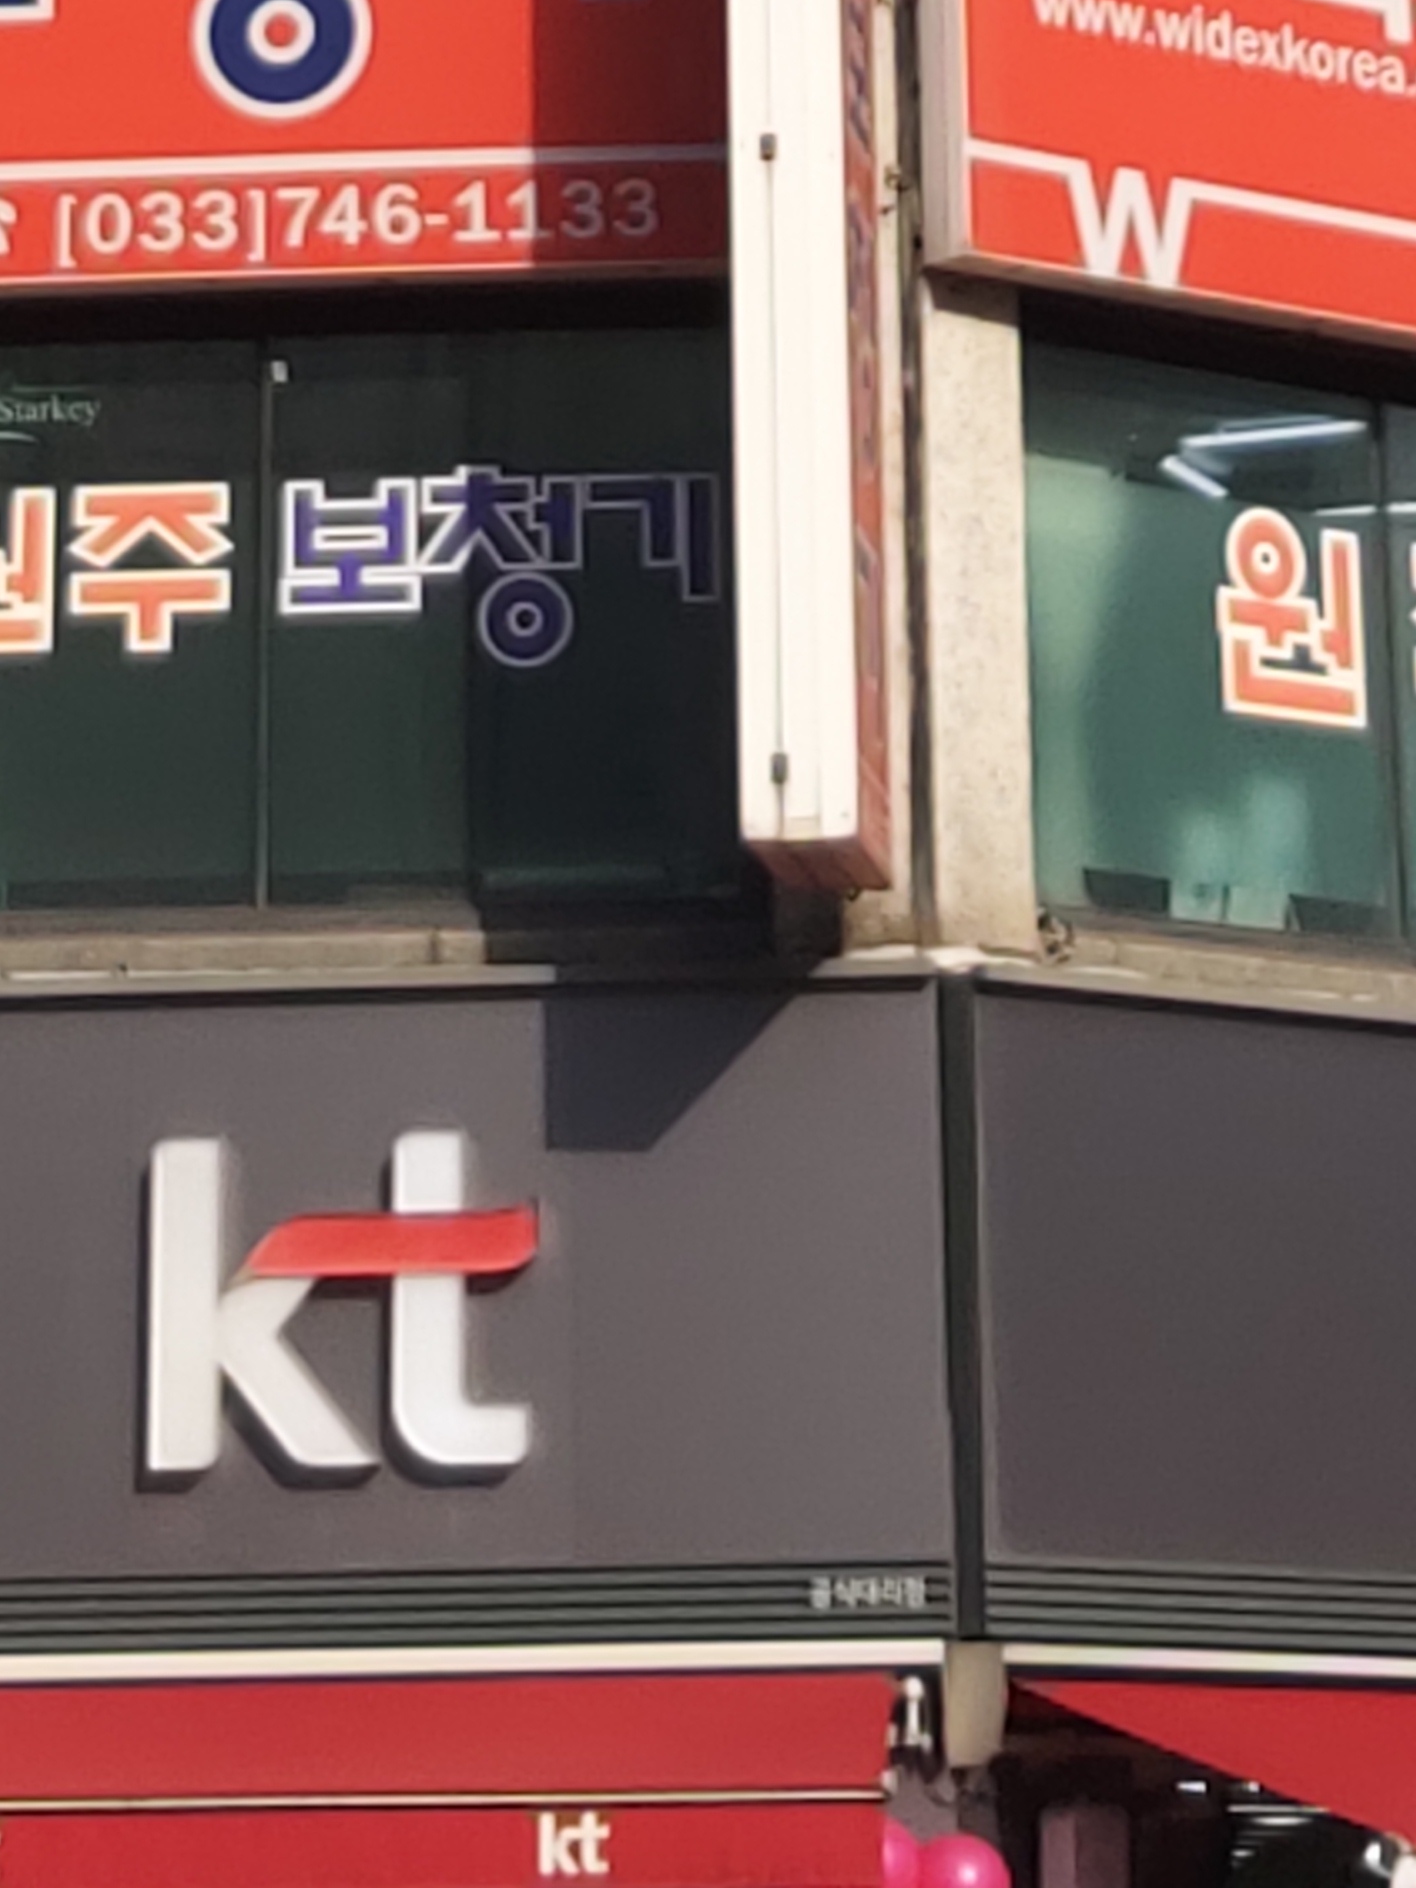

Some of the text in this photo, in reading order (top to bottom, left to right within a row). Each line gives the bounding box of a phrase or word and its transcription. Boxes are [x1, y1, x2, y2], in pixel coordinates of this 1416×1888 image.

[277, 463, 720, 667] 보청기
[143, 1129, 540, 1474] kt
[537, 1812, 611, 1877] kt
